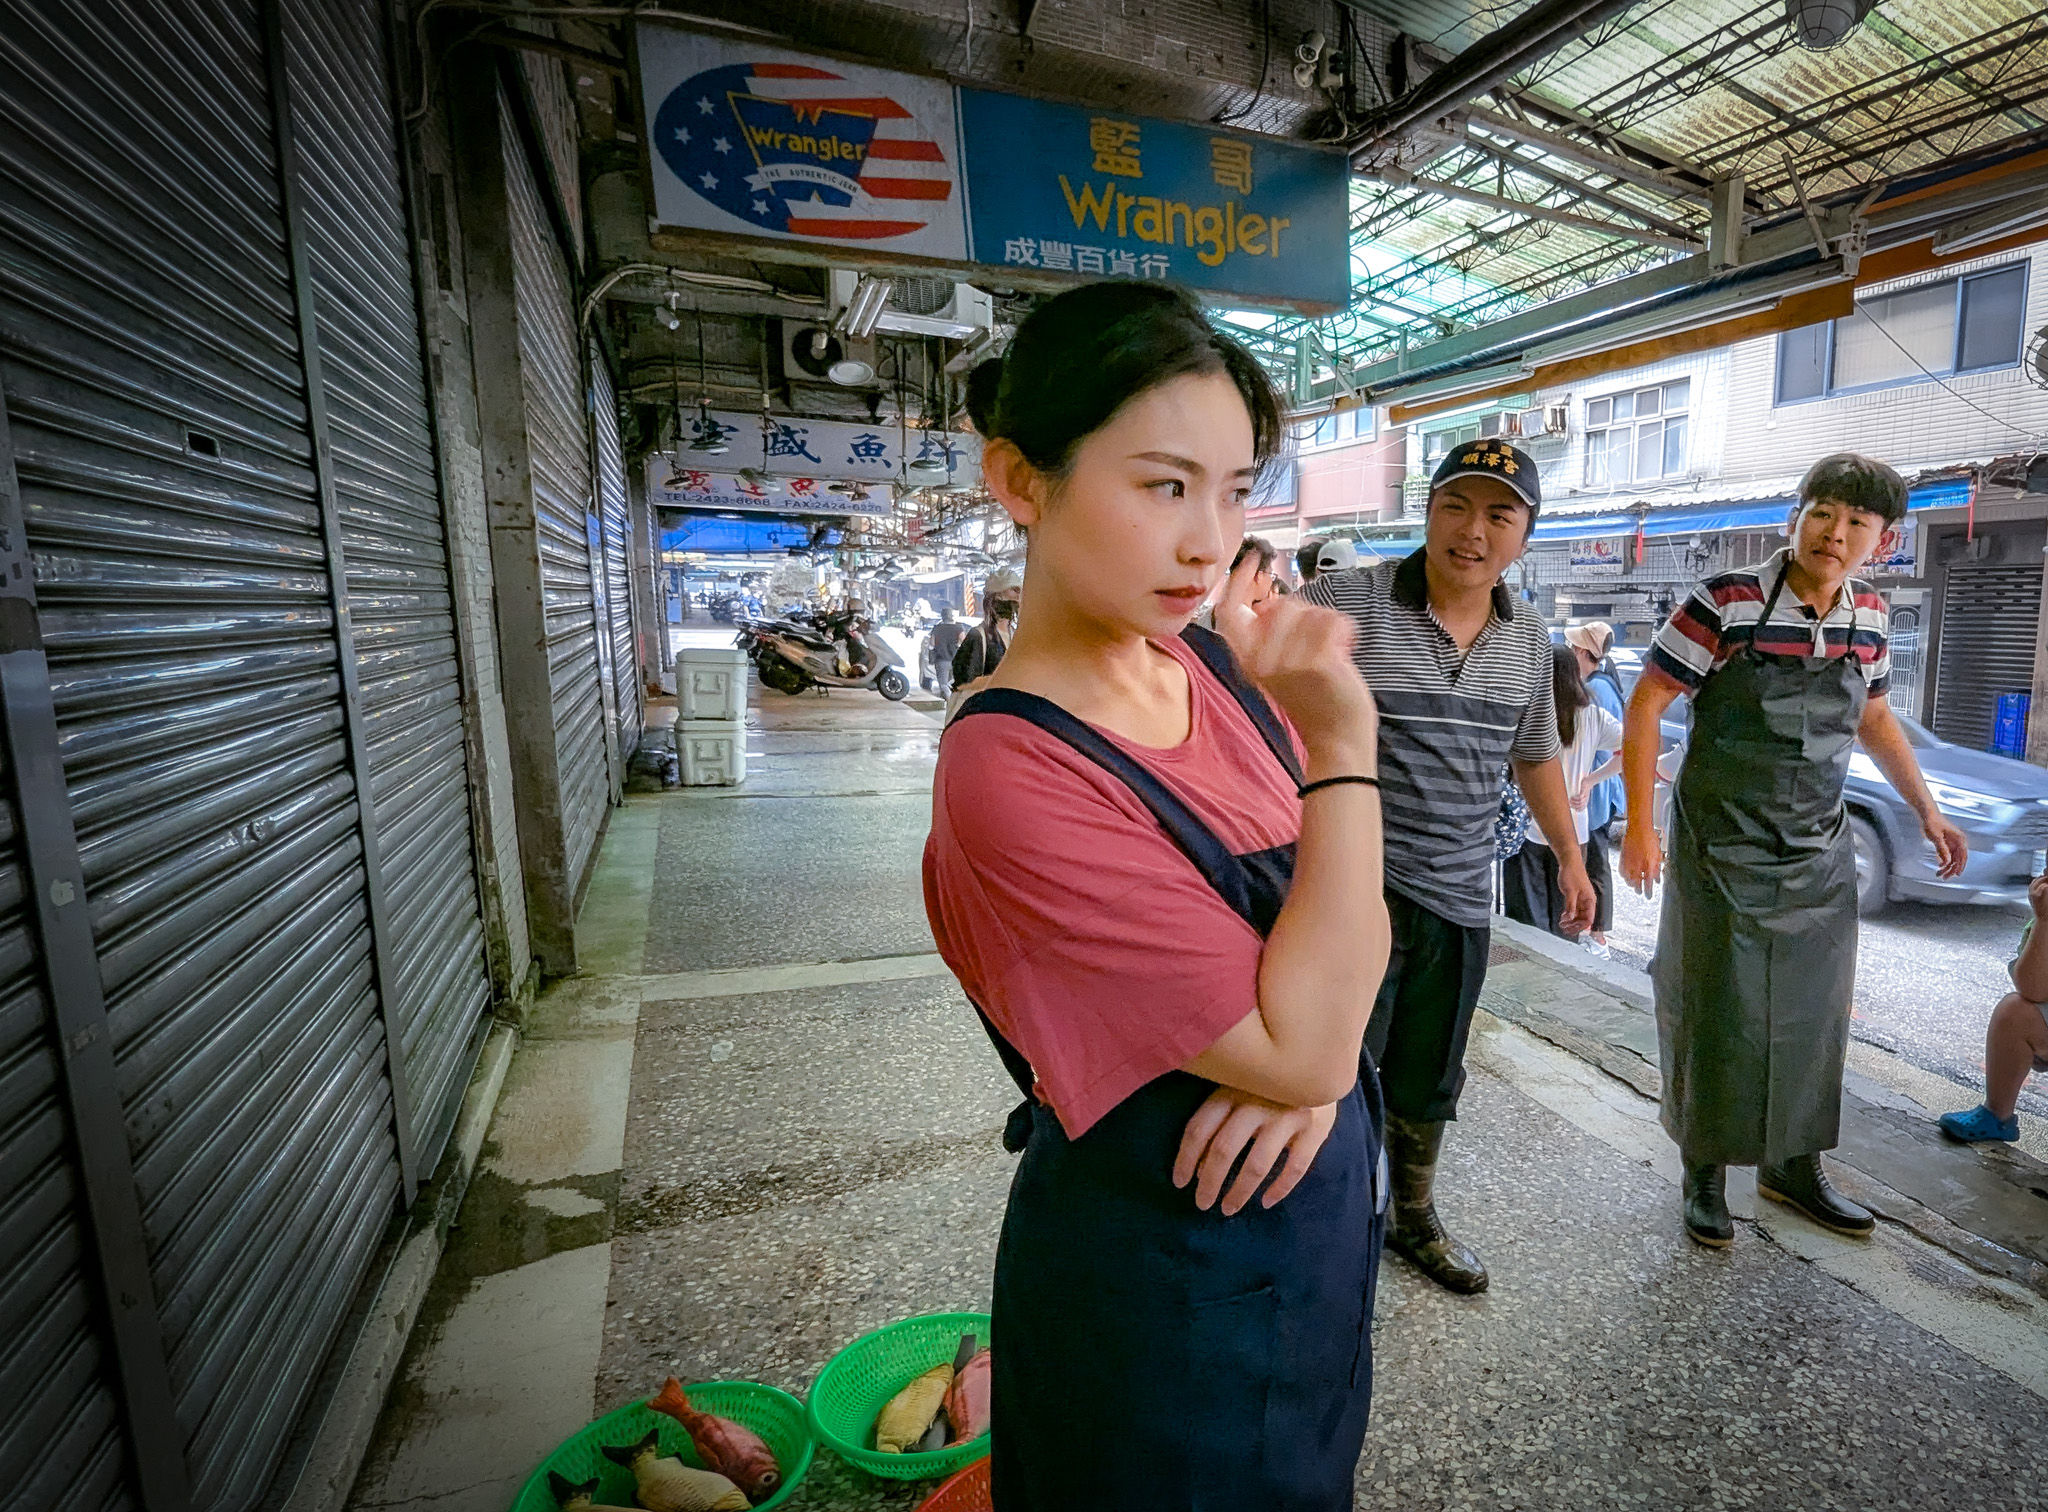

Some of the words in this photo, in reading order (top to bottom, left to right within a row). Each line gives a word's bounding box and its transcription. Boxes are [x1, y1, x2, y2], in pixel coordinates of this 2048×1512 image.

[750, 126, 867, 162] Wrangler
[1058, 174, 1291, 268] Wrangler
[1004, 236, 1171, 280] 成豐百貨行
